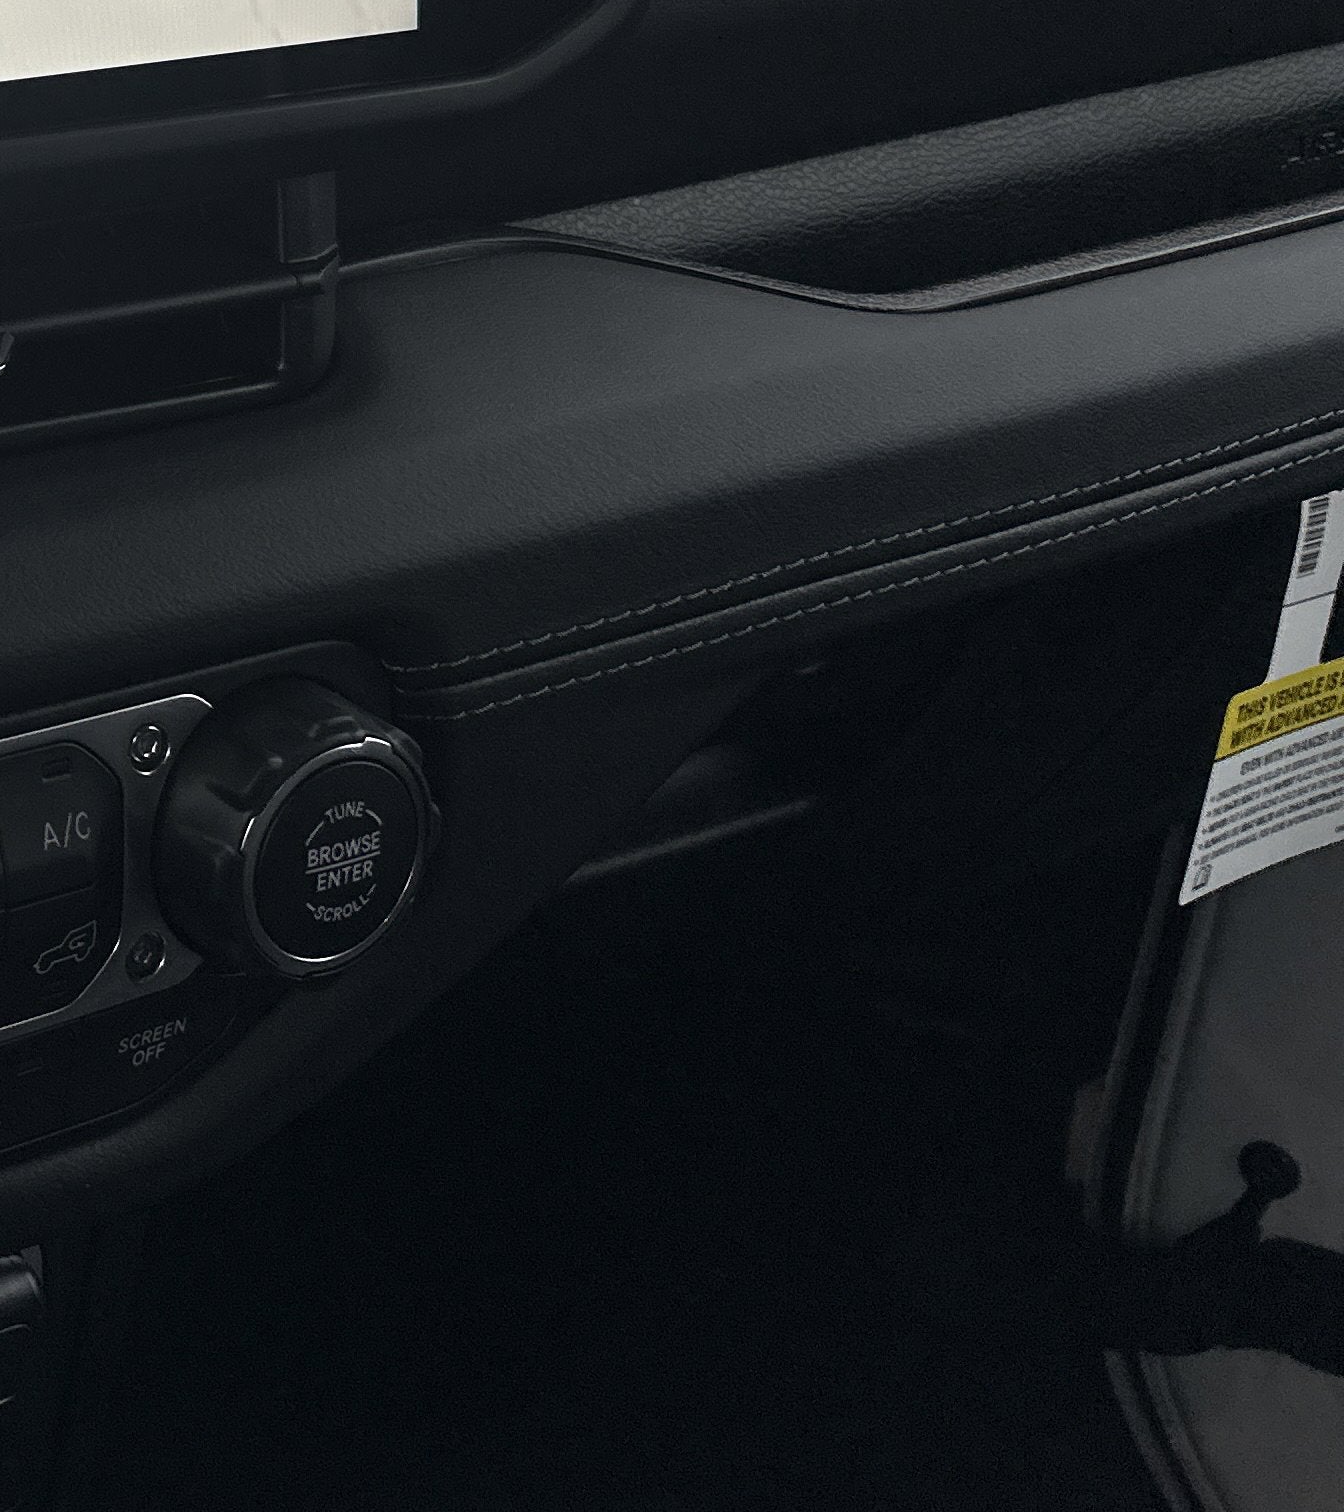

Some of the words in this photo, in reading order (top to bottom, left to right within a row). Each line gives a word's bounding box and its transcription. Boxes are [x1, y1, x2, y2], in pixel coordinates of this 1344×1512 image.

[324, 800, 366, 824] TUNE
[42, 811, 92, 851] A/C
[306, 832, 383, 869] BROWSE
[315, 862, 375, 893] ENTER
[311, 894, 370, 924] SCROLL
[117, 1018, 187, 1054] SCREEN
[130, 1043, 168, 1068] OFF
